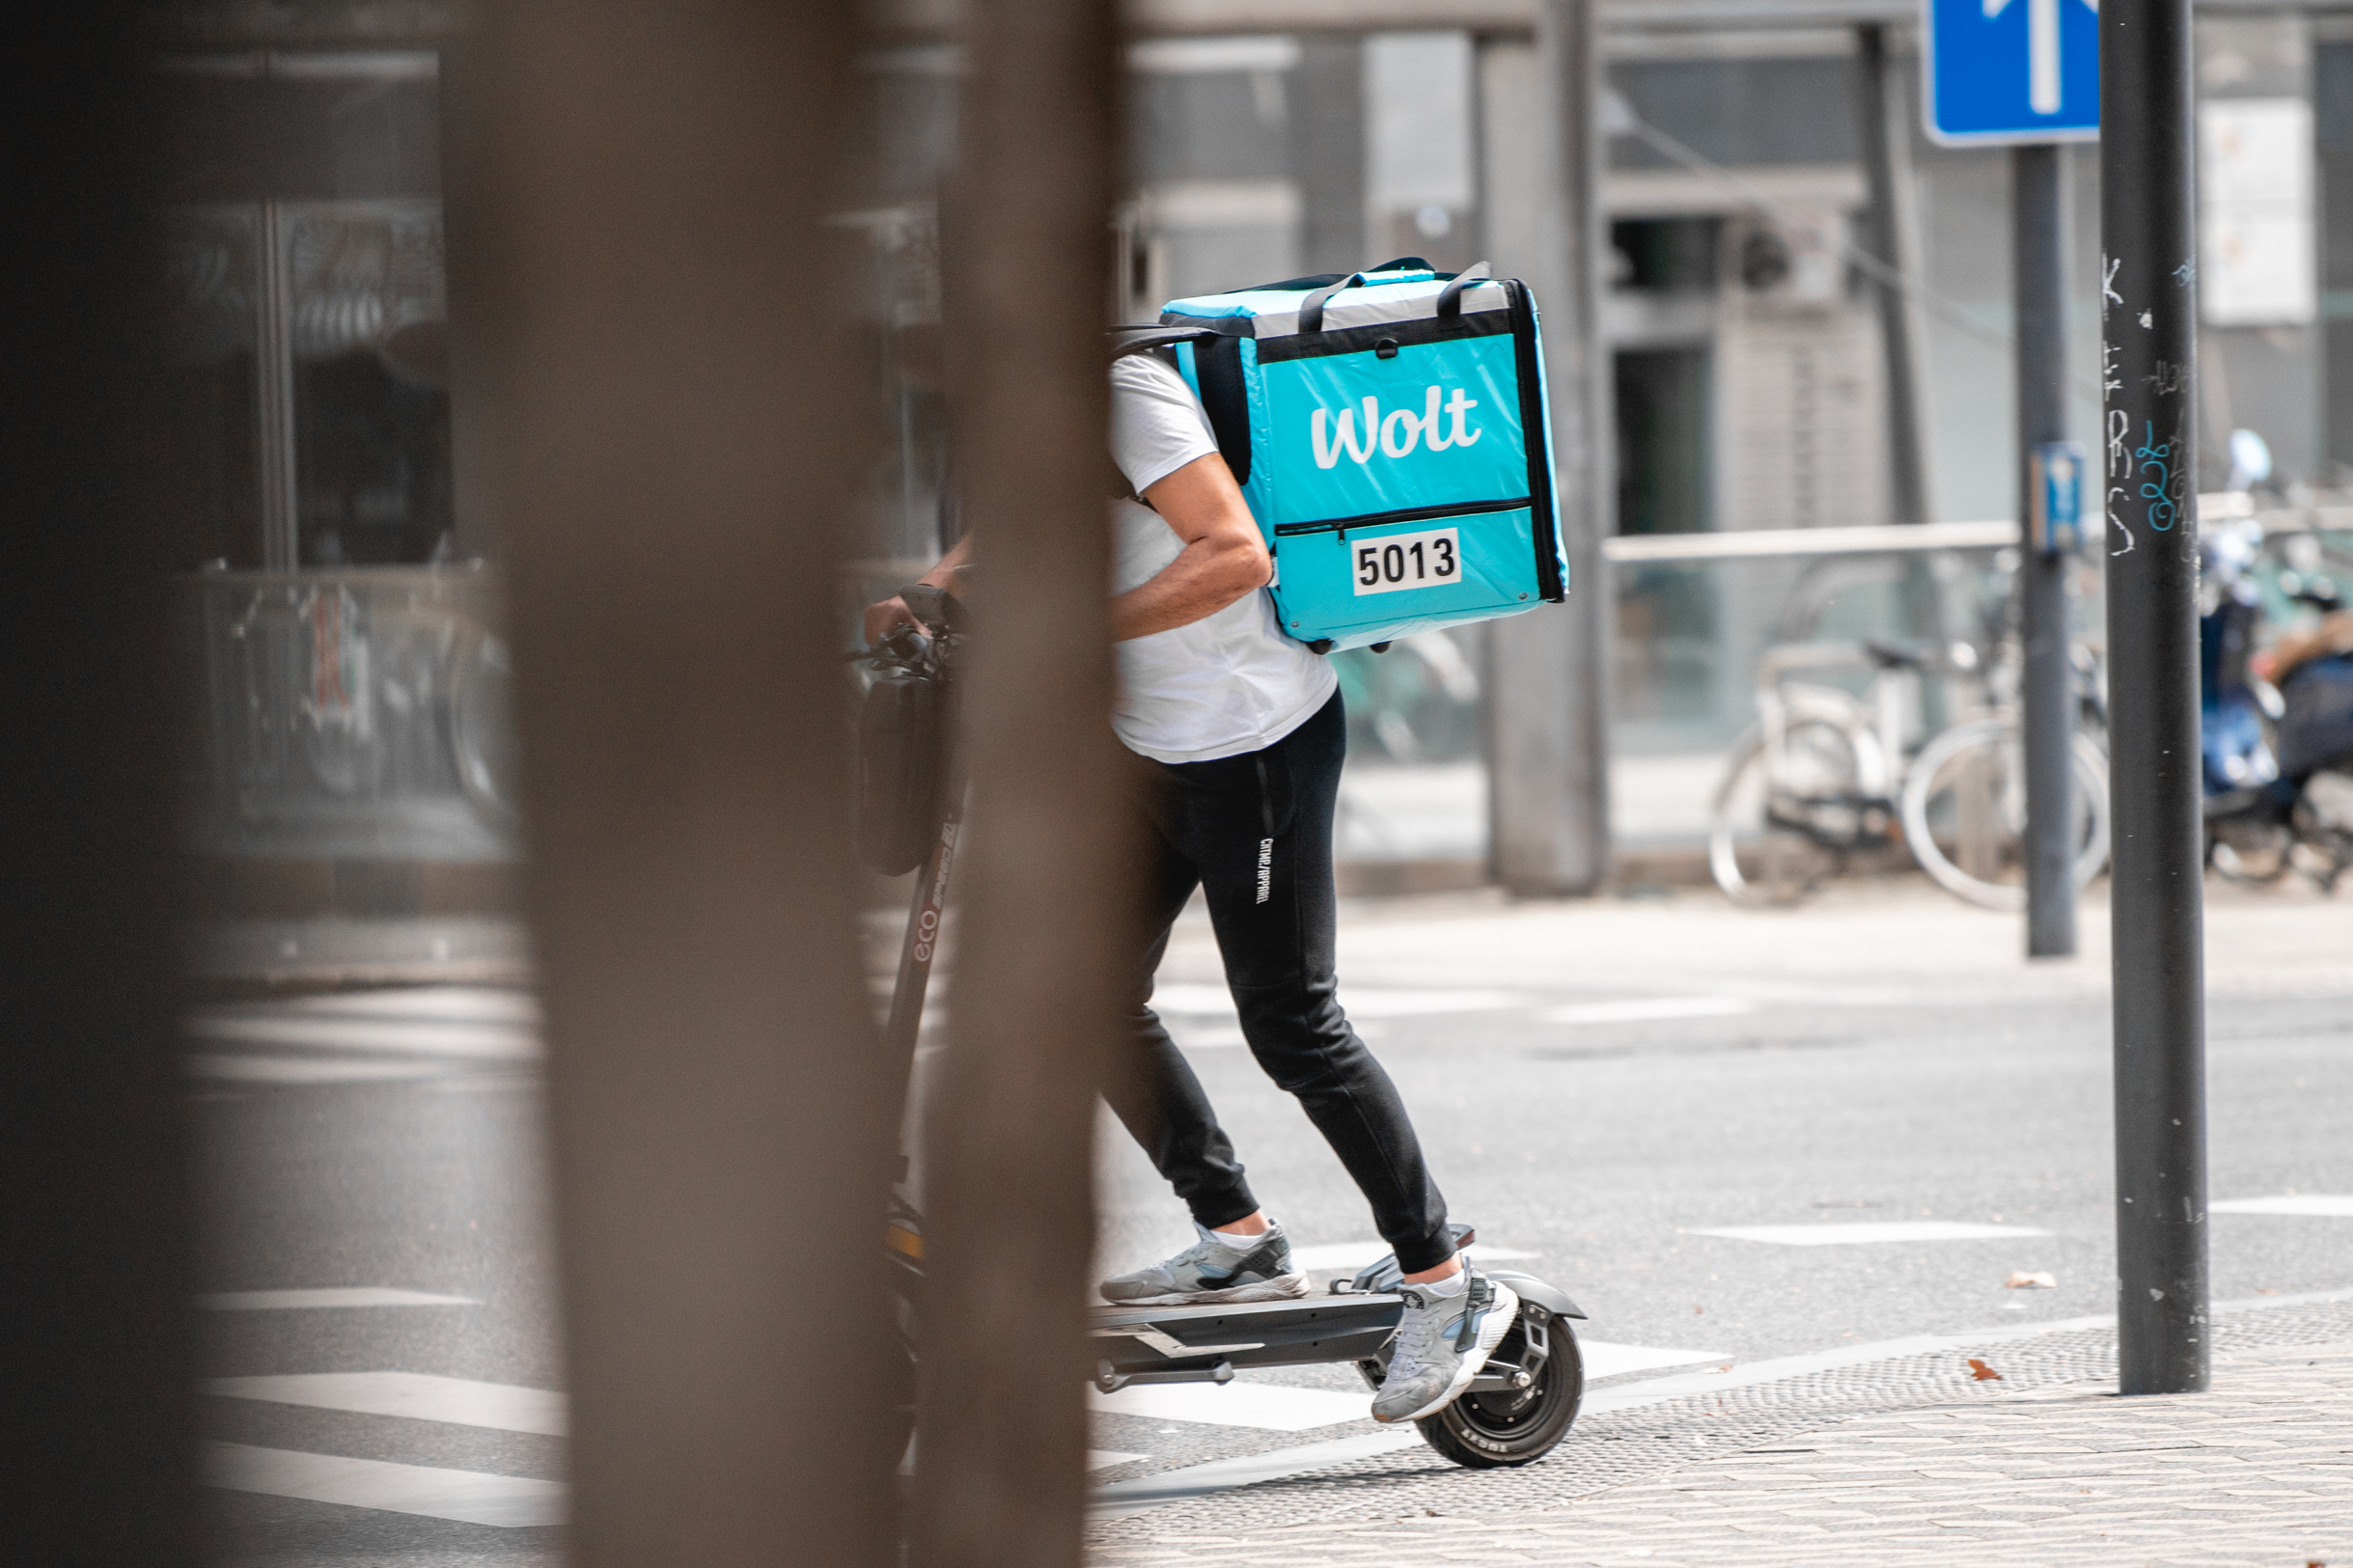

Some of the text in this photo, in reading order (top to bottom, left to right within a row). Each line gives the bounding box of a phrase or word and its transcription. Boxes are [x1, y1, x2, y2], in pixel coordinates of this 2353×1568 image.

[1311, 385, 1482, 470] Wolt
[1359, 537, 1455, 586] 5013
[914, 910, 938, 962] eco
